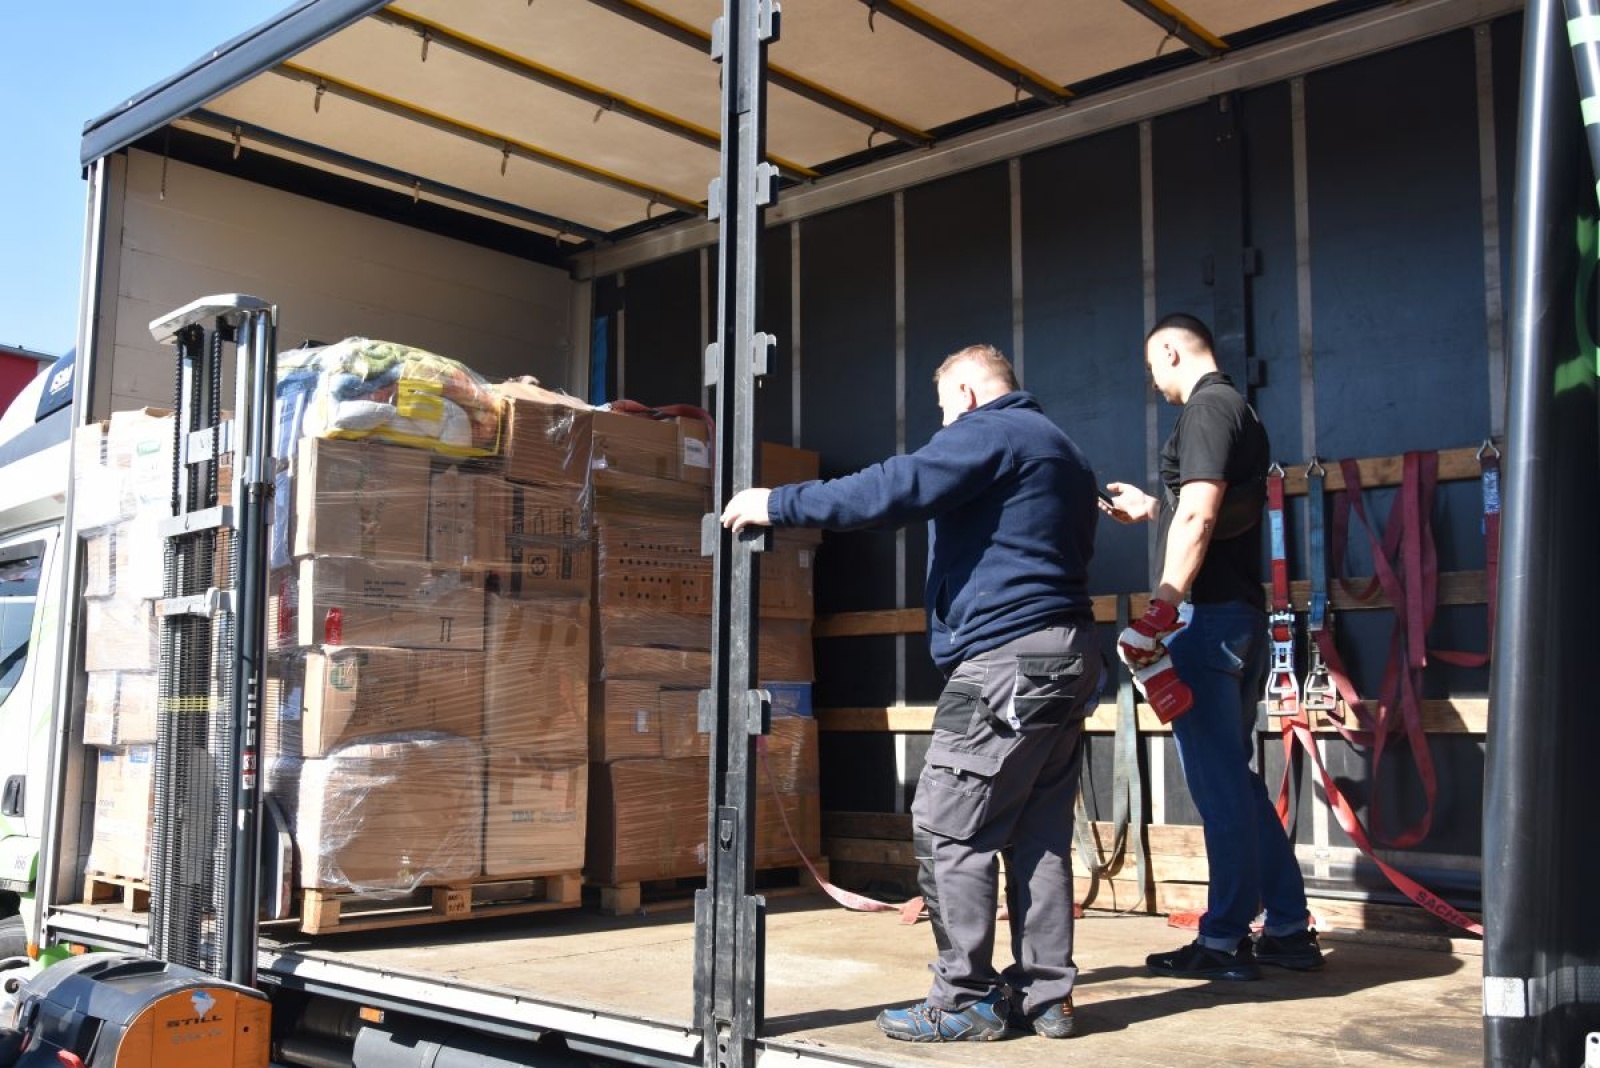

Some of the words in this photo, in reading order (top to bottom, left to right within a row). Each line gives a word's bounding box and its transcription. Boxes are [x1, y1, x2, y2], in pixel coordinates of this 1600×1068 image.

[246, 669, 259, 746] STILL
[1416, 891, 1468, 926] SACHS
[167, 1014, 223, 1028] STILL
